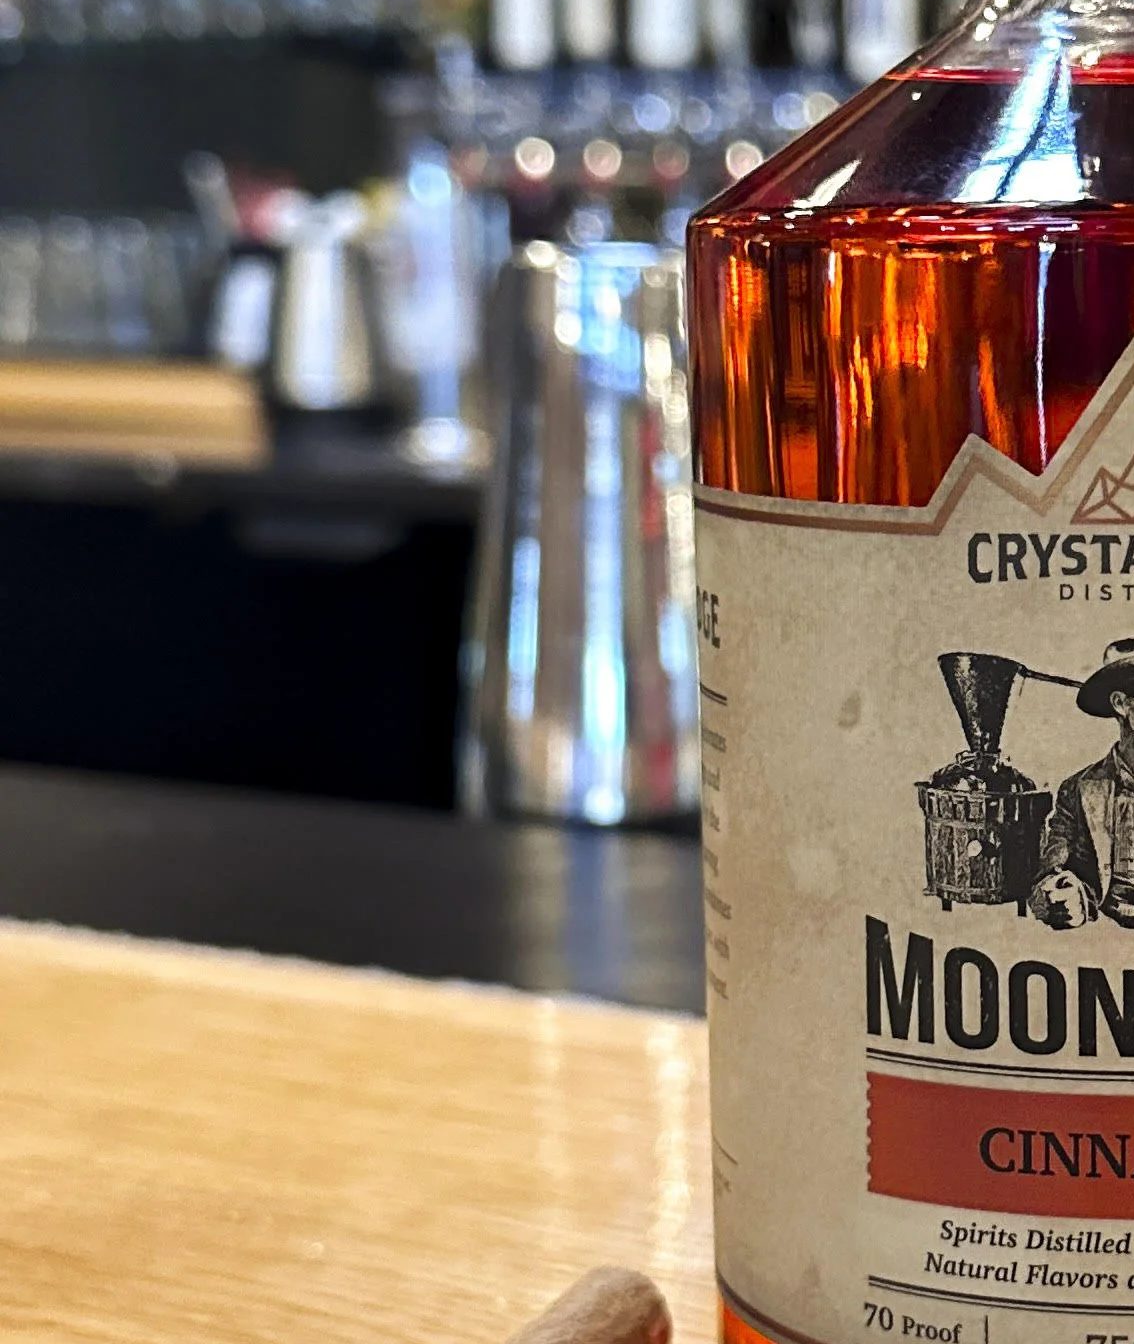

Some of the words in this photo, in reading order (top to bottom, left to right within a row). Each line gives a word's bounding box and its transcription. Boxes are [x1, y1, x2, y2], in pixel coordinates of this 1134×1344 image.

[940, 1219, 1018, 1248] Spirits
[1025, 1228, 1132, 1255] Distilled
[924, 1251, 1018, 1283] Natural
[1024, 1263, 1118, 1290] Flavors
[863, 1302, 894, 1332] 70
[901, 1315, 963, 1344] Proof
